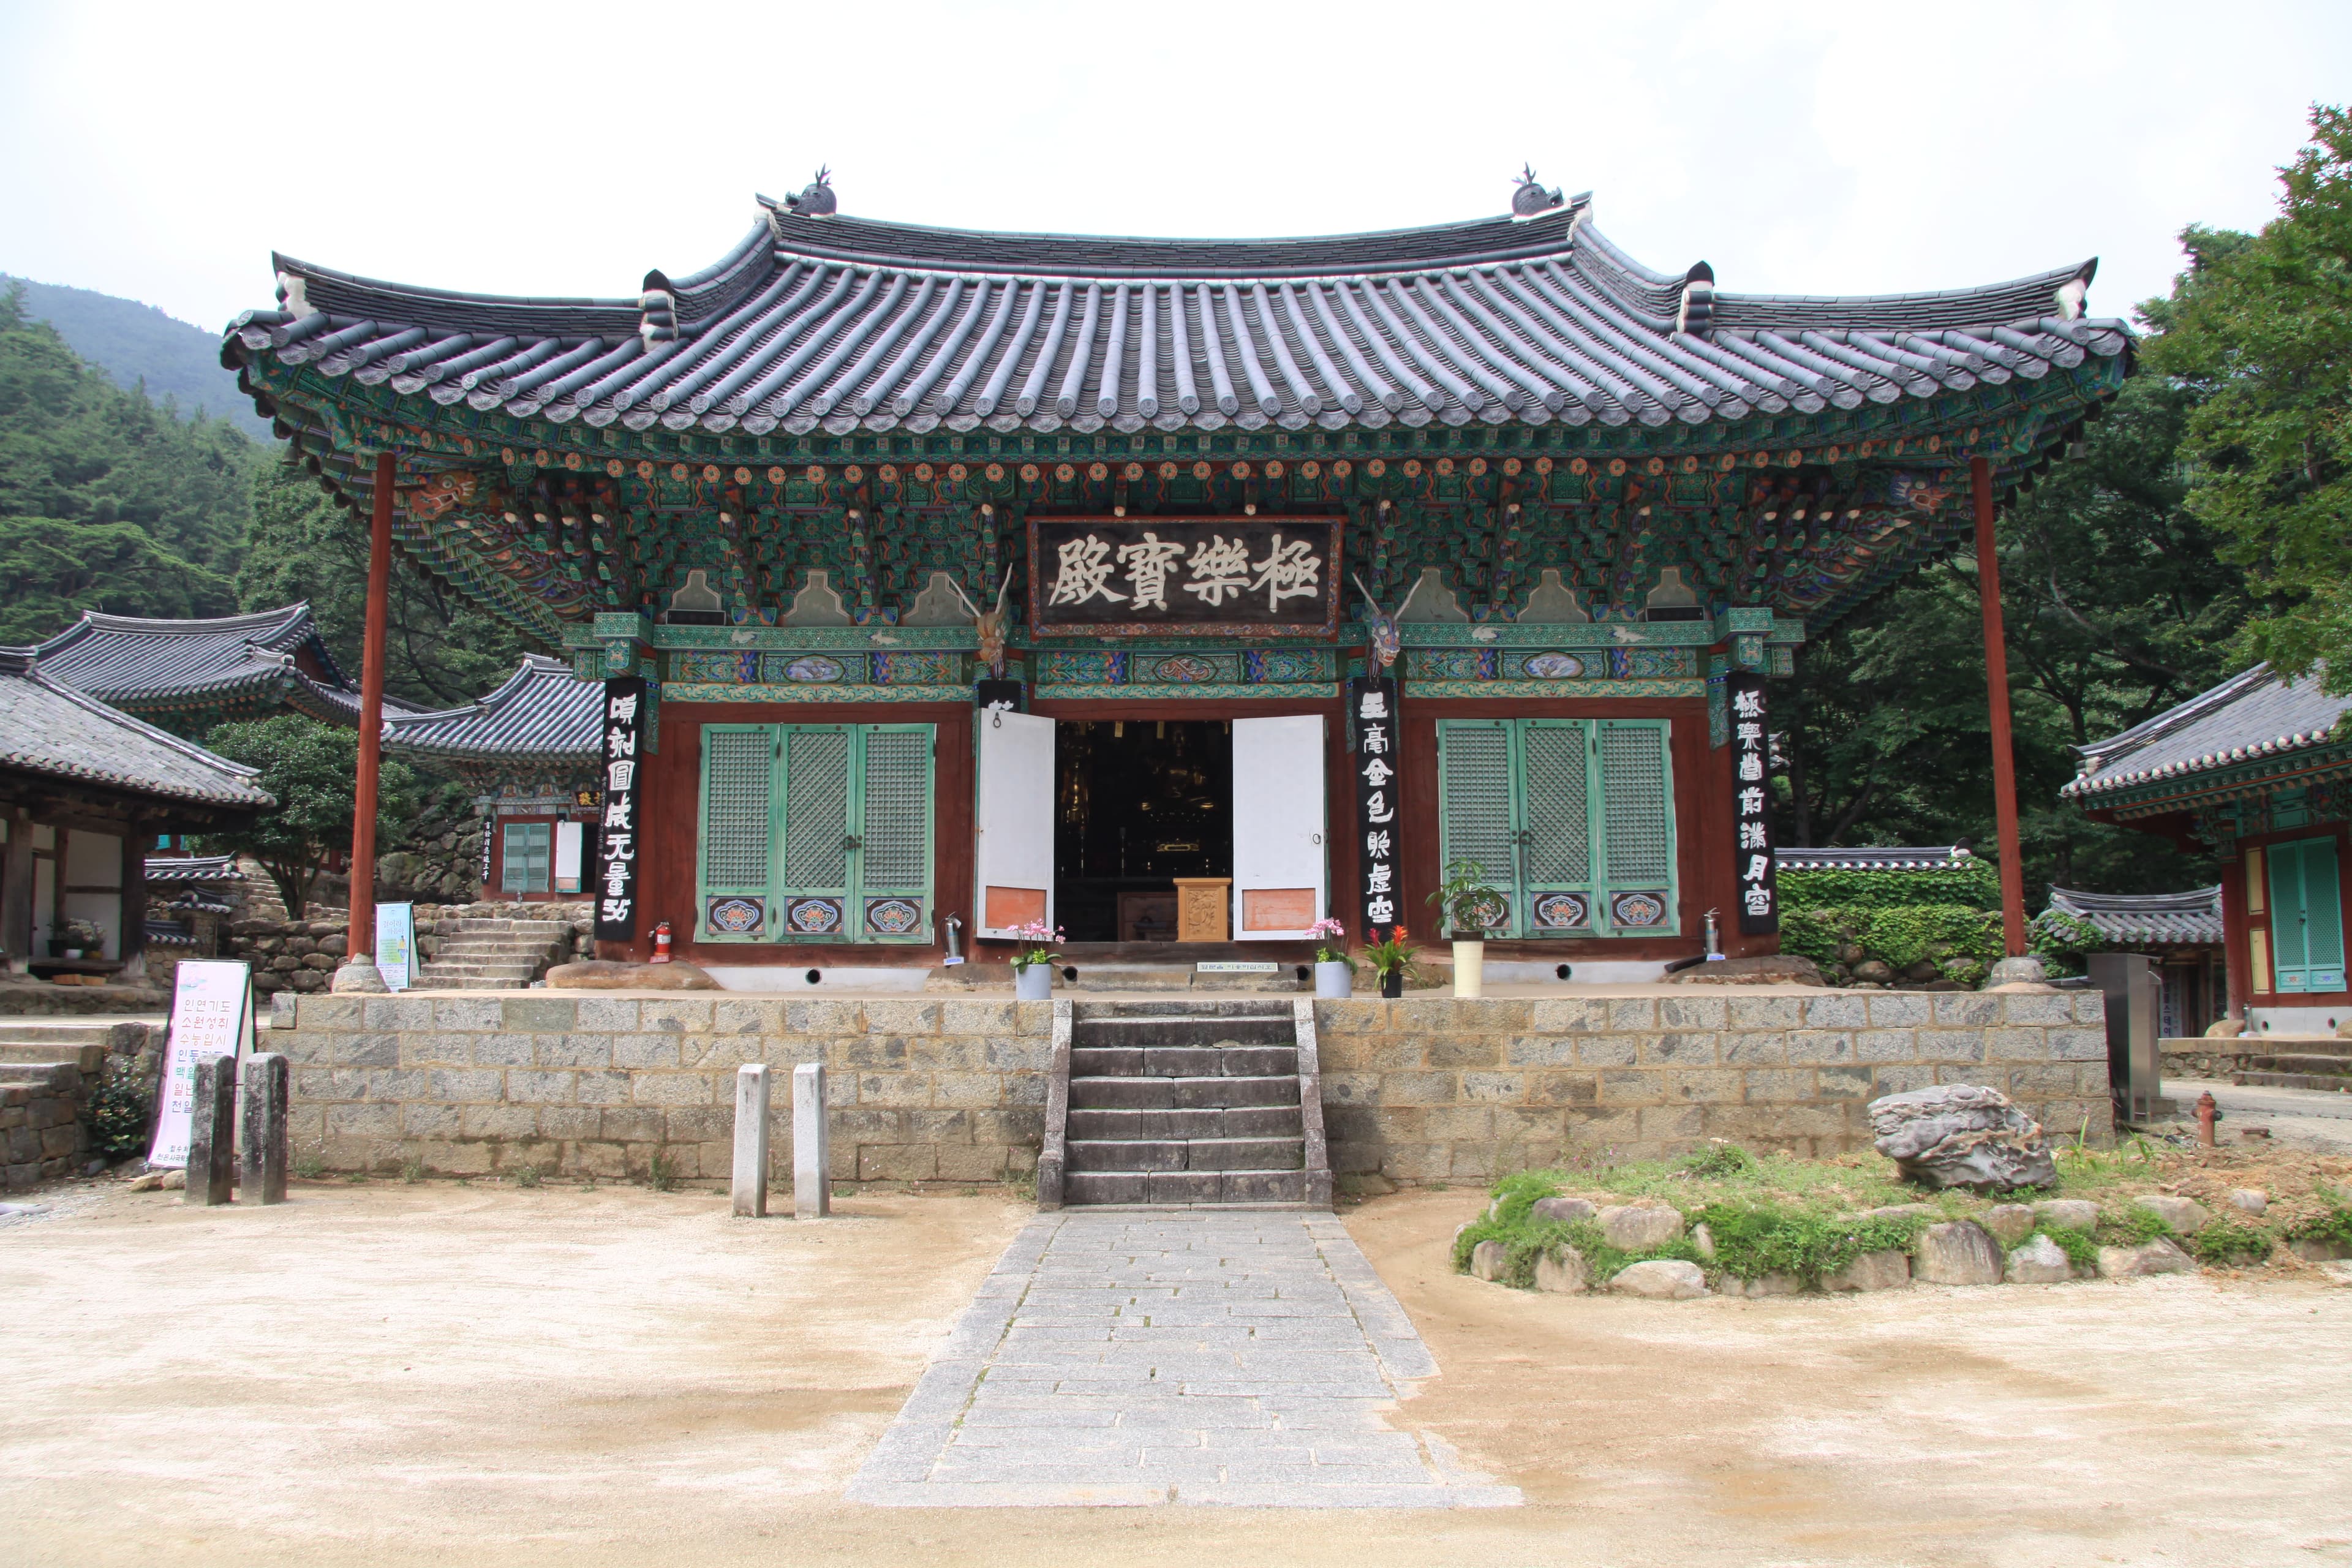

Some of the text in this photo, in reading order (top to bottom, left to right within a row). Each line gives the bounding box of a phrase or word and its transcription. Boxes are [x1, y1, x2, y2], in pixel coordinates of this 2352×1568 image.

[184, 999, 230, 1012] 인연기도
[181, 1016, 228, 1030] 소원성취
[179, 1033, 226, 1046] 수능입시
[178, 1049, 224, 1063] 인등
